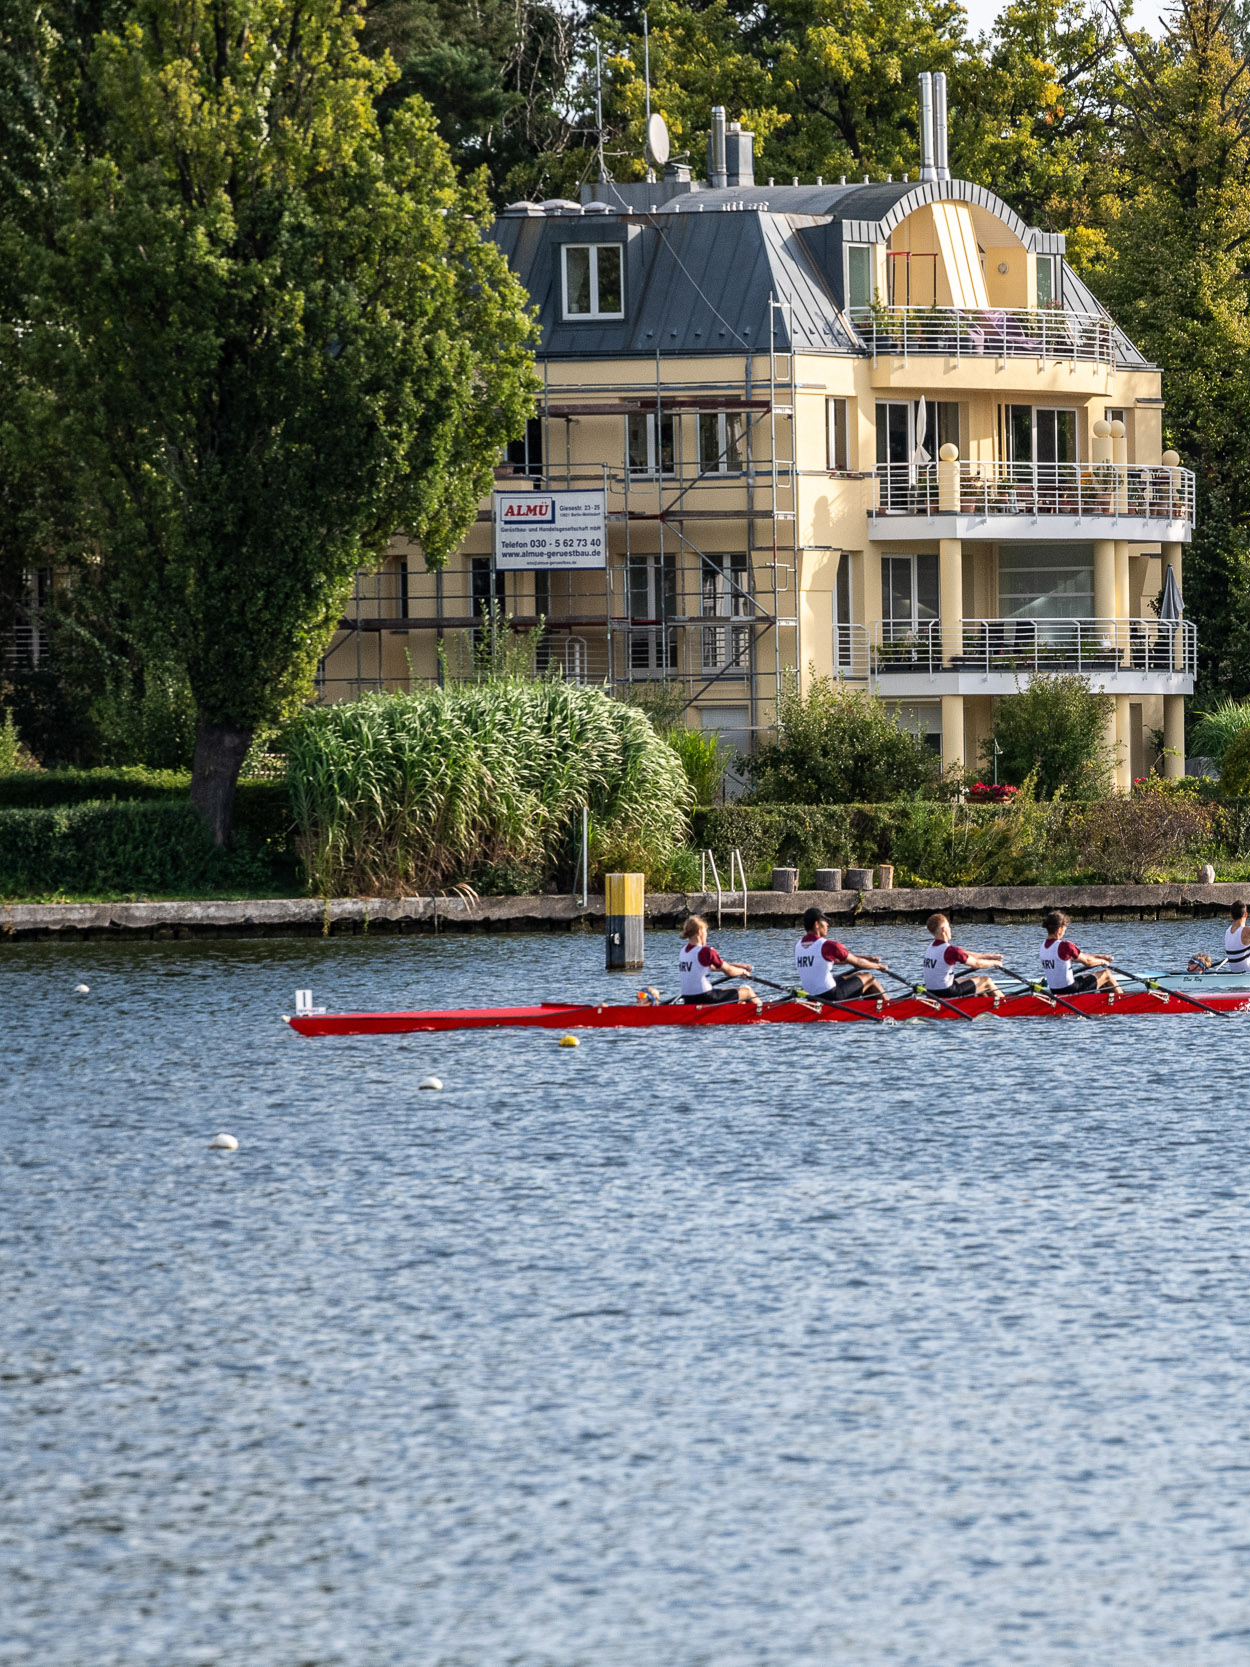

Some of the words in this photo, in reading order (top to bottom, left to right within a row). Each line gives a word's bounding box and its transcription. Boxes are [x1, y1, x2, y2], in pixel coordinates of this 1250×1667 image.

[504, 501, 549, 517] ALMÜ
[530, 539, 547, 548] 030
[554, 539, 560, 548] 5
[562, 539, 574, 548] 62
[576, 538, 587, 547] 73
[590, 538, 601, 547] 40
[501, 549, 601, 559] www.almue-geruestbau.de
[797, 955, 814, 967] HRV
